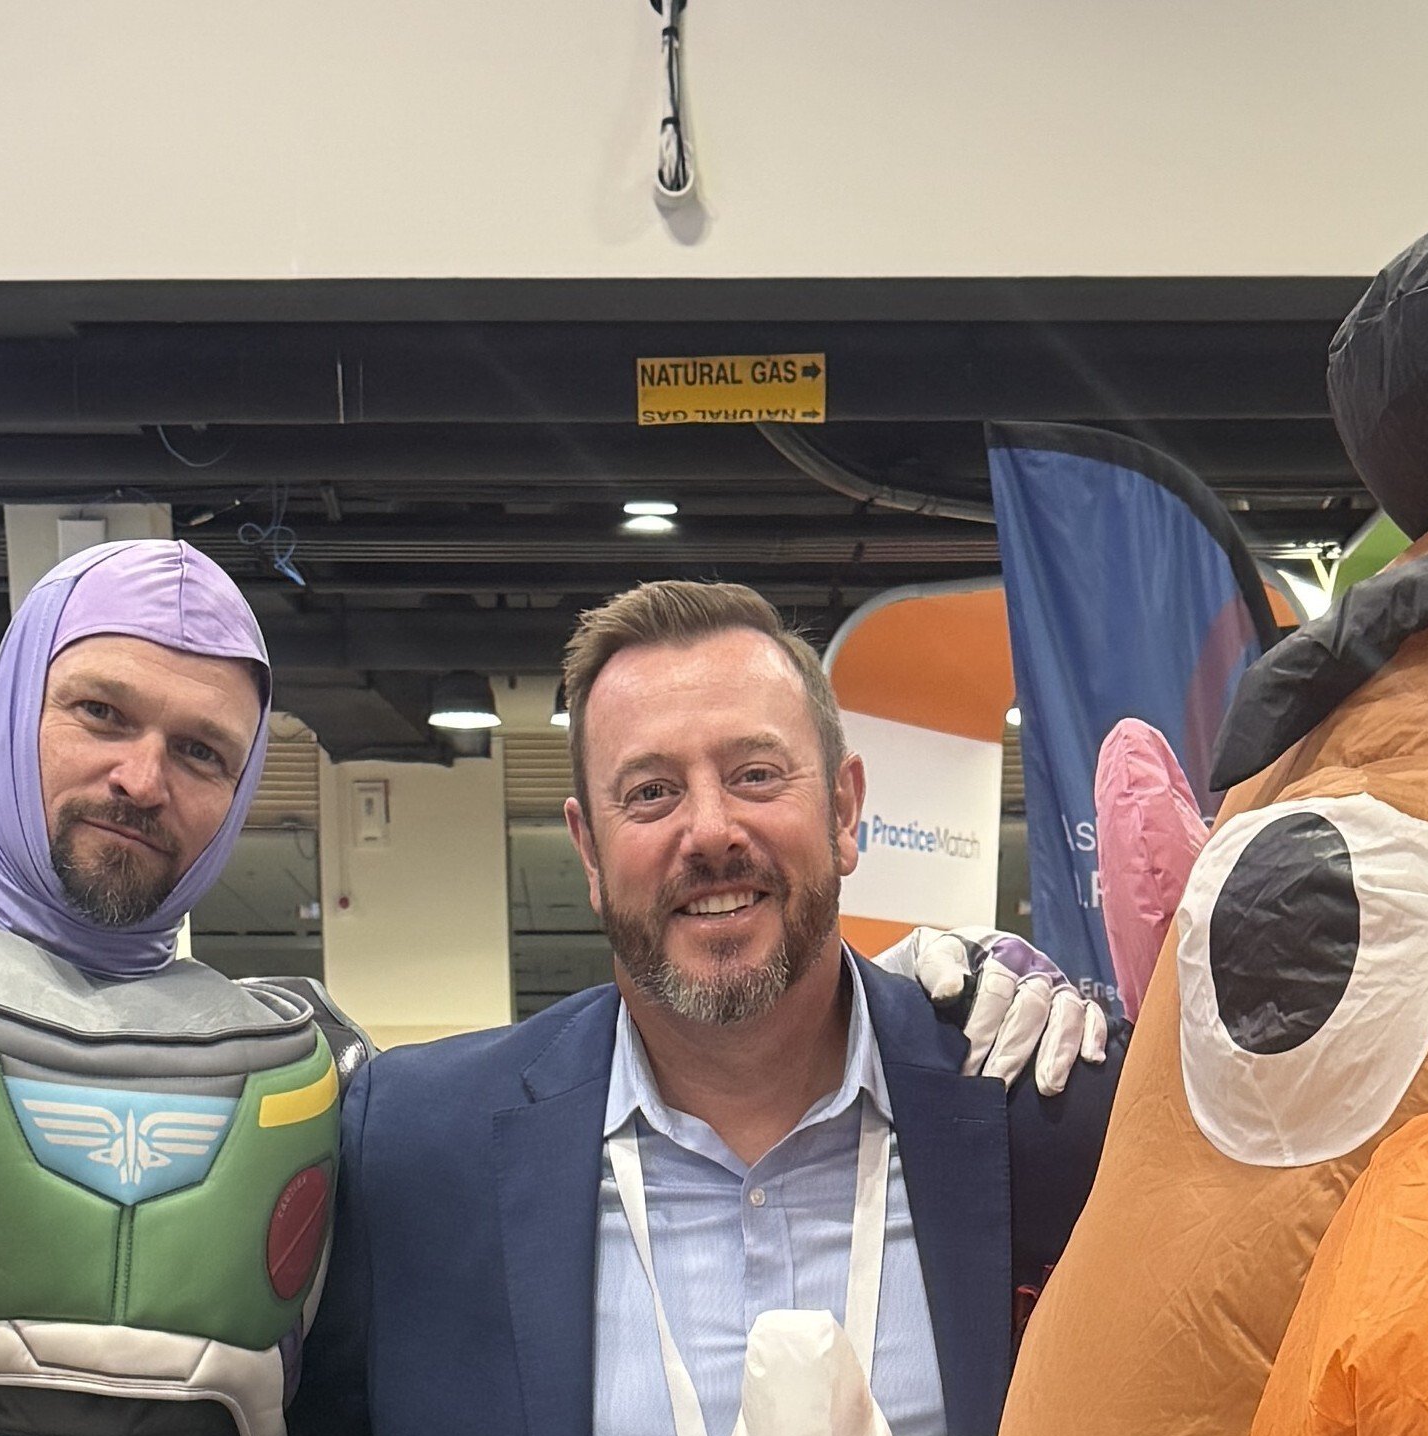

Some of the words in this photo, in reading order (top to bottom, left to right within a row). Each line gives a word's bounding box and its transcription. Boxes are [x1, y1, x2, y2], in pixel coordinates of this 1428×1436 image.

[641, 361, 742, 386] NATURAL
[751, 360, 797, 383] GAS
[642, 409, 688, 423] GAS
[695, 408, 796, 422] NATURAL
[872, 814, 980, 860] PracticeMatch
